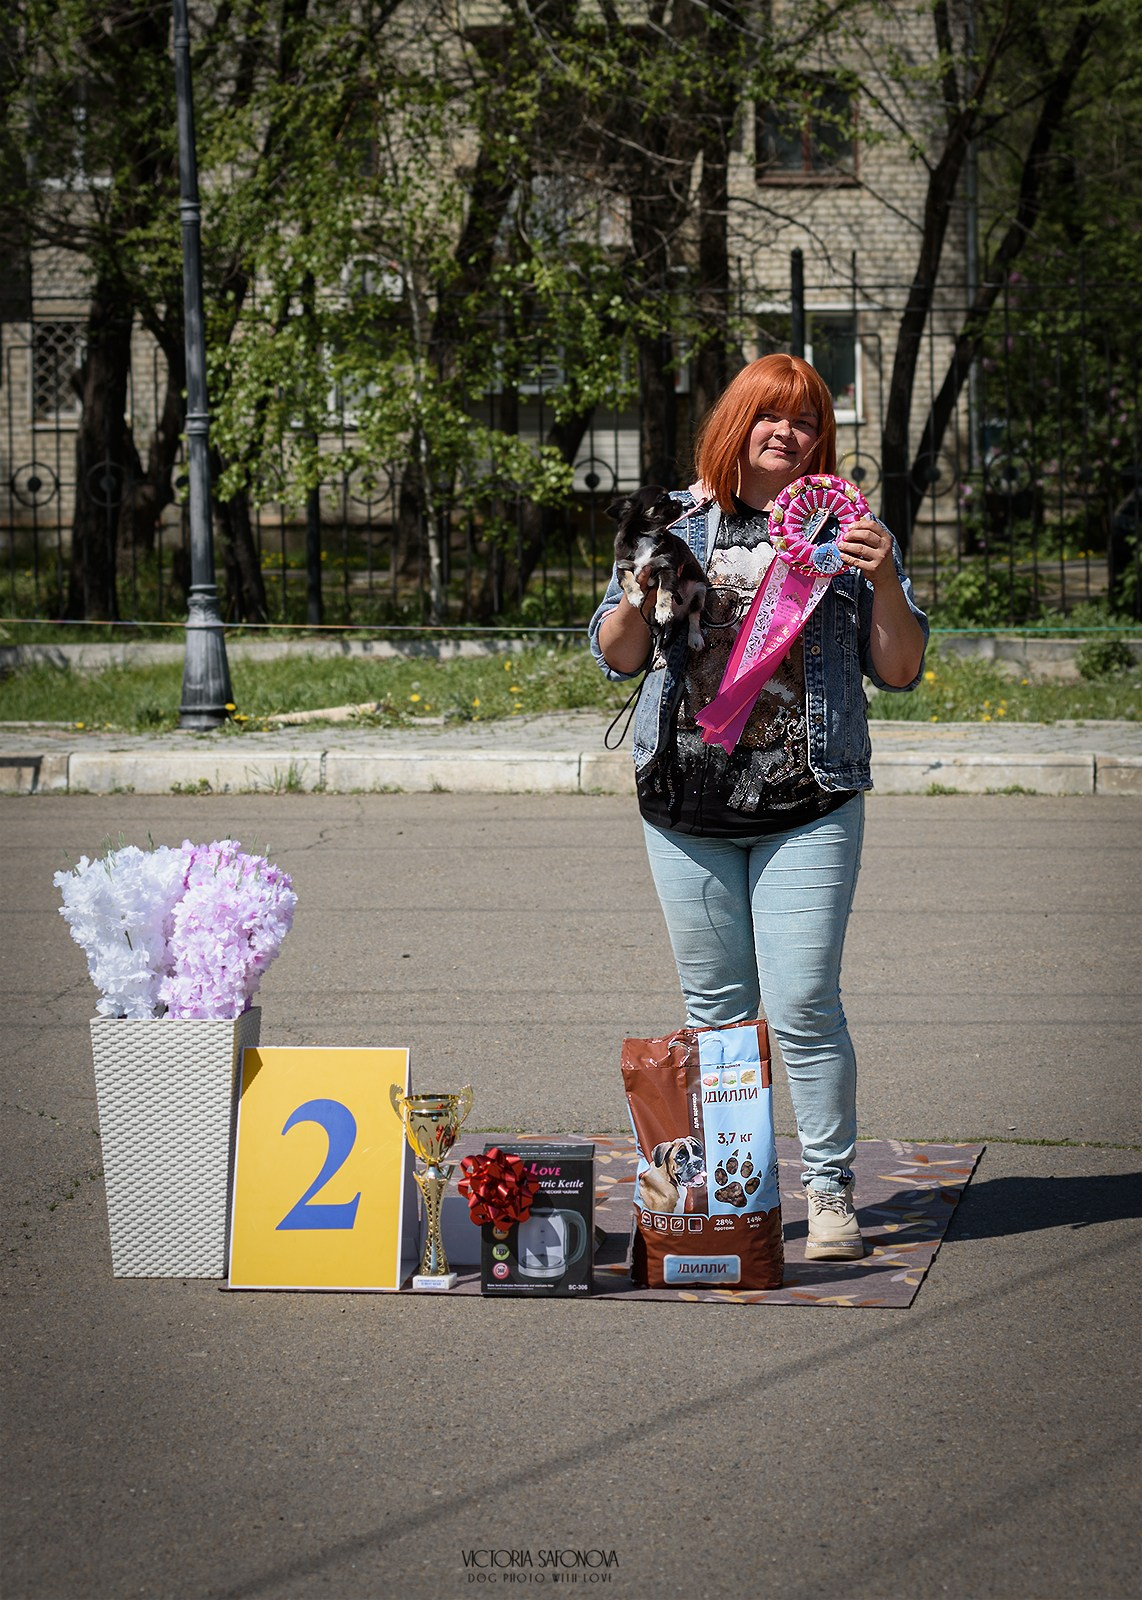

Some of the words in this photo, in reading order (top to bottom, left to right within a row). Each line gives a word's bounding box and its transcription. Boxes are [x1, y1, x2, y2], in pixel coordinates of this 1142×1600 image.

[704, 1087, 758, 1103] ДИЛЛИ
[717, 1132, 737, 1146] 3,7
[740, 1133, 753, 1143] кг
[275, 1098, 361, 1230] 2
[557, 1179, 584, 1188] Kettle
[715, 1218, 734, 1226] 28%
[678, 1263, 727, 1273] ДИЛЛИ
